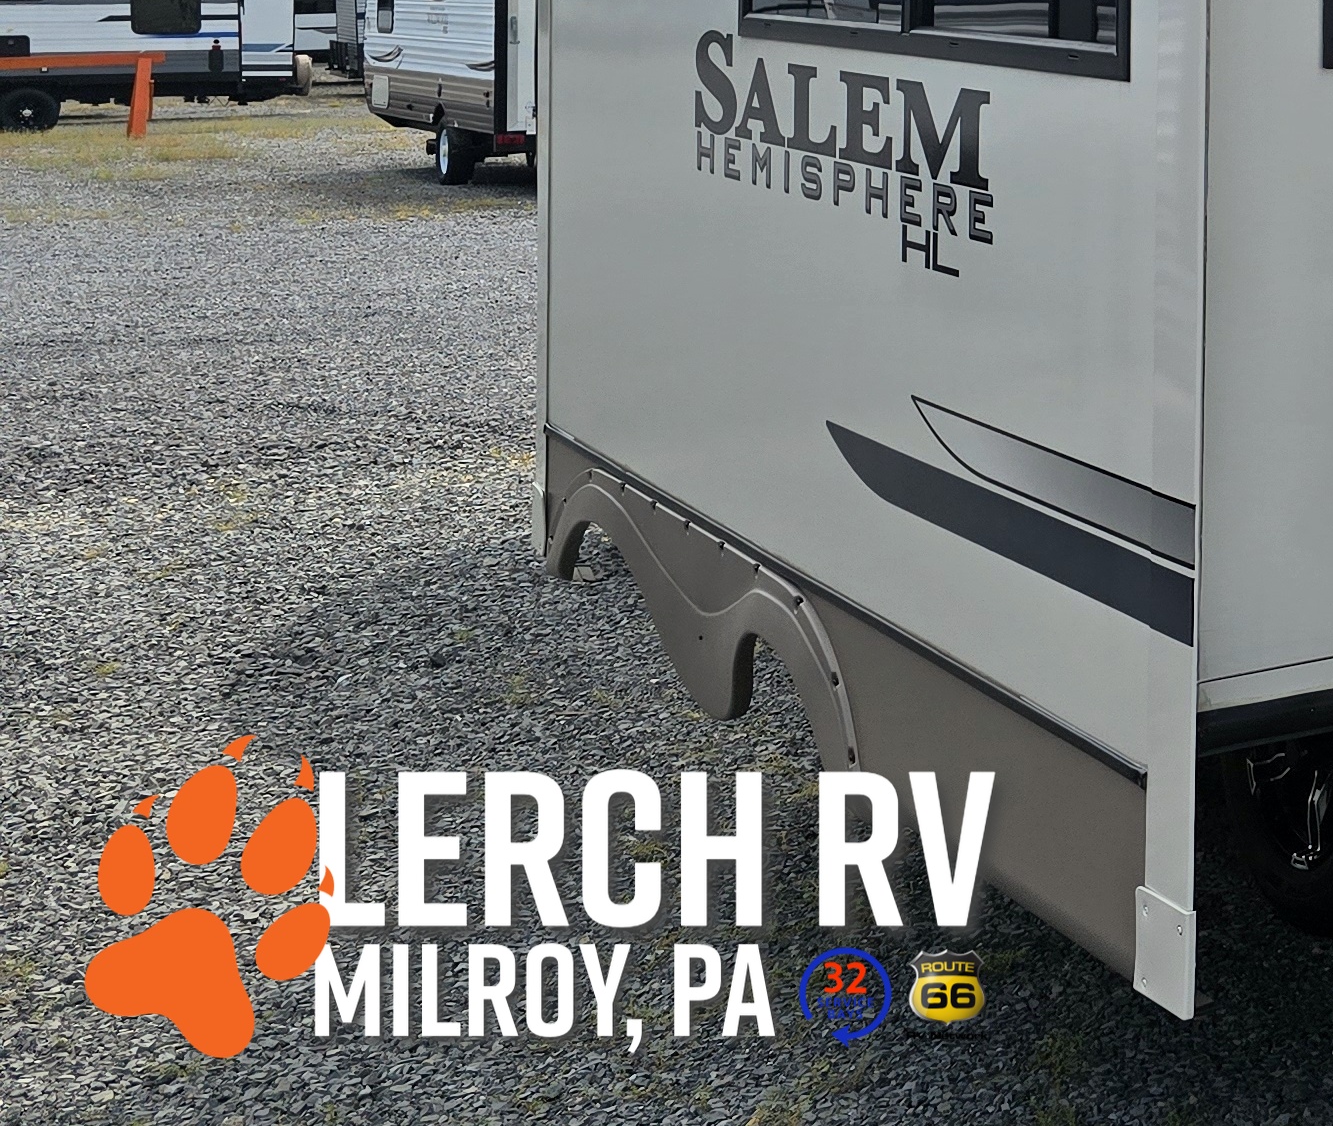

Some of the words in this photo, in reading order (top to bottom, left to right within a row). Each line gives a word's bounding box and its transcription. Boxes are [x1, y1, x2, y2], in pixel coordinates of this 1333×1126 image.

[694, 29, 991, 192] SALEM
[696, 130, 994, 245] HEMISPHERE
[901, 224, 960, 278] HL
